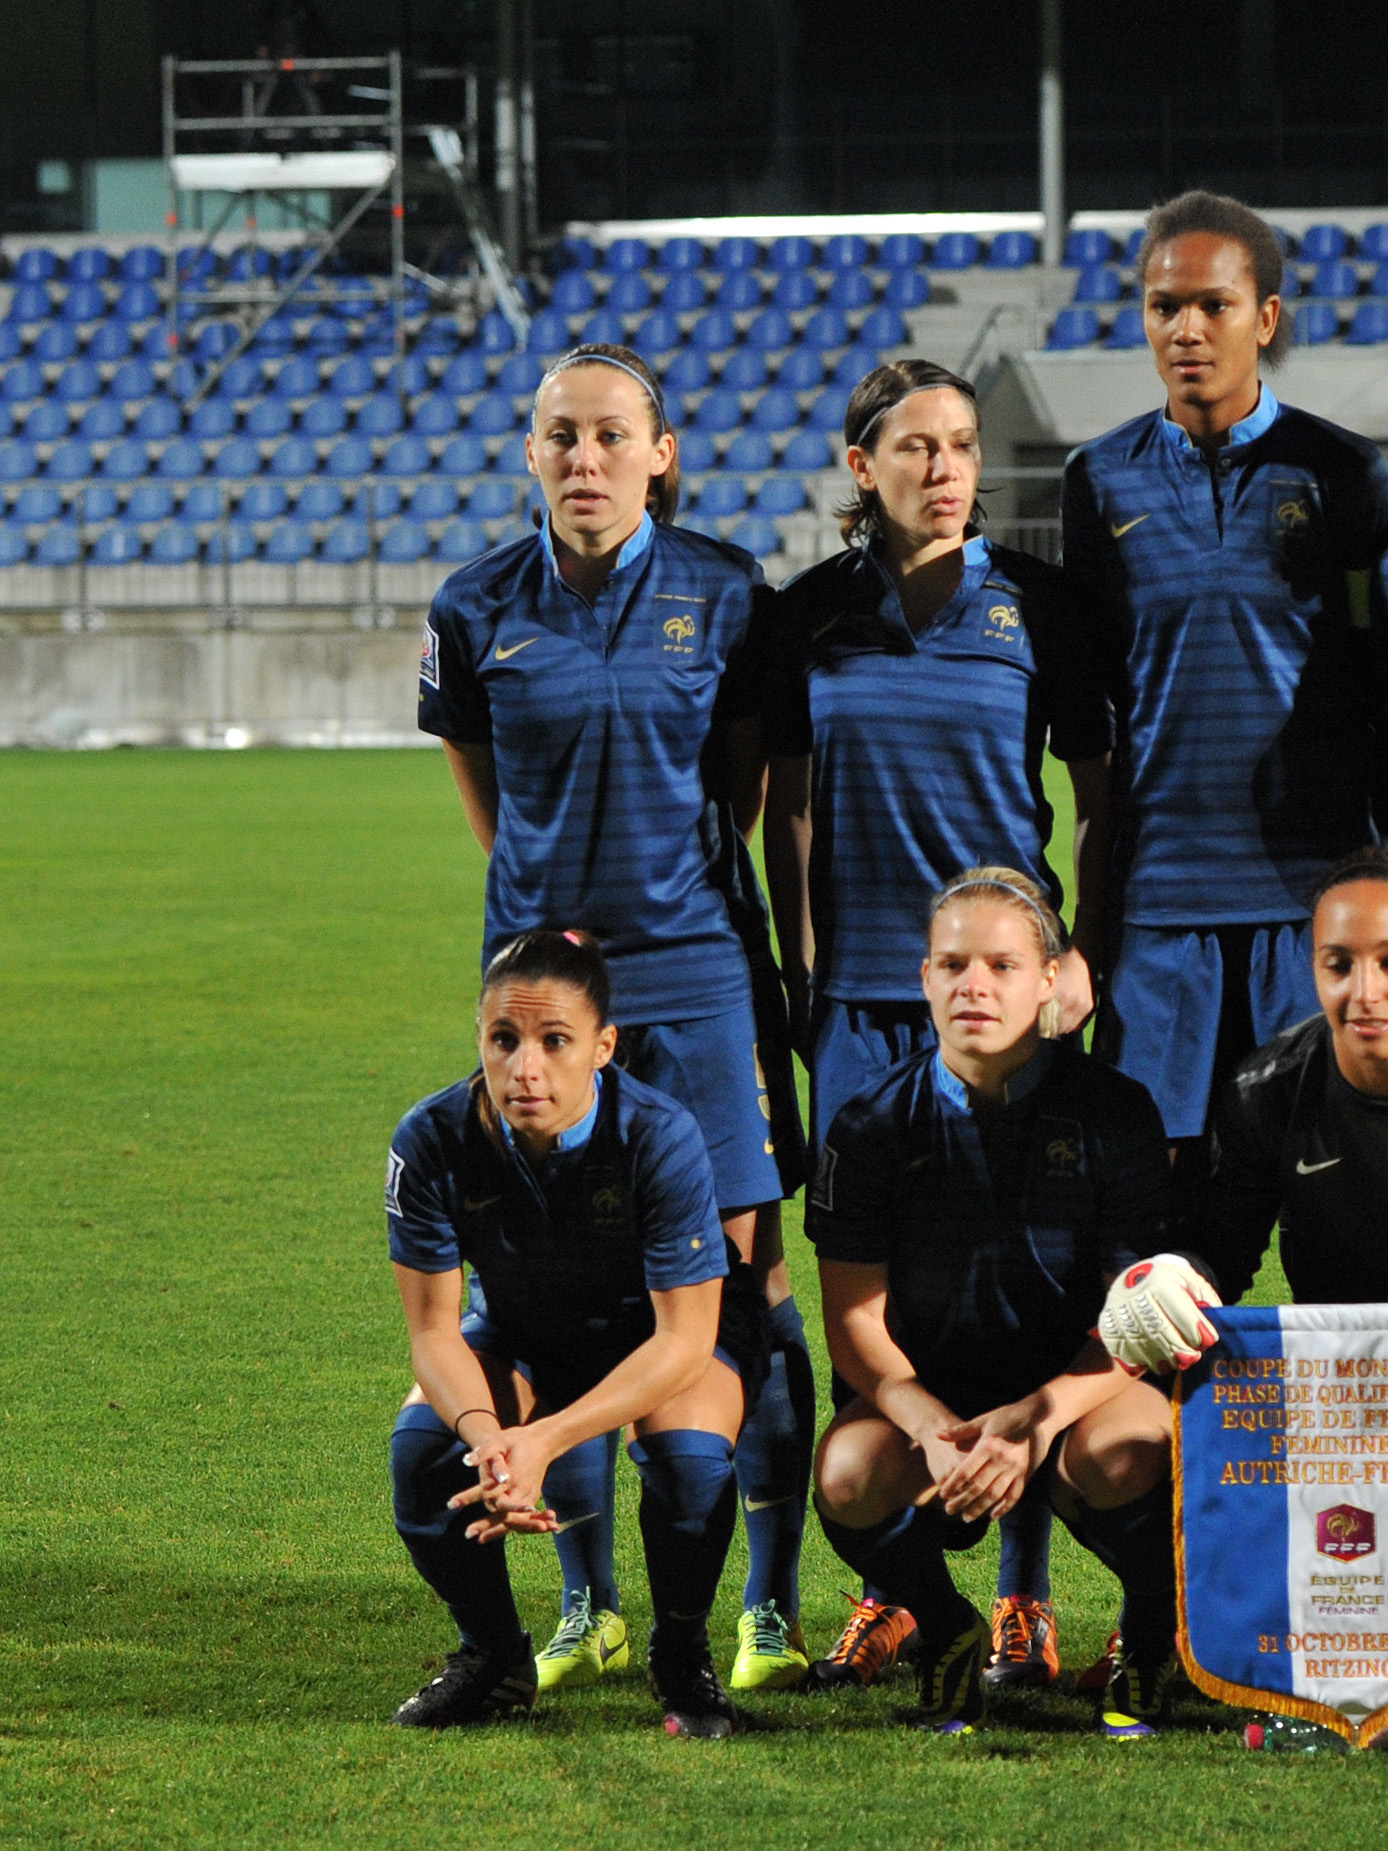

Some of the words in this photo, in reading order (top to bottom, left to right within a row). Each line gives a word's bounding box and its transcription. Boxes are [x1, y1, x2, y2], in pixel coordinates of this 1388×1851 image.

[1213, 1358, 1292, 1379] COUPE
[1297, 1359, 1328, 1378] DU
[1213, 1384, 1281, 1404] PHASE
[1286, 1384, 1313, 1404] DE
[1222, 1409, 1316, 1432] EQUIPE
[1322, 1409, 1356, 1429] DE
[1324, 1542, 1371, 1553] FFF
[1310, 1573, 1385, 1586] ÉQUIPE
[1311, 1595, 1385, 1605] FRANCE
[1257, 1633, 1279, 1653] 31
